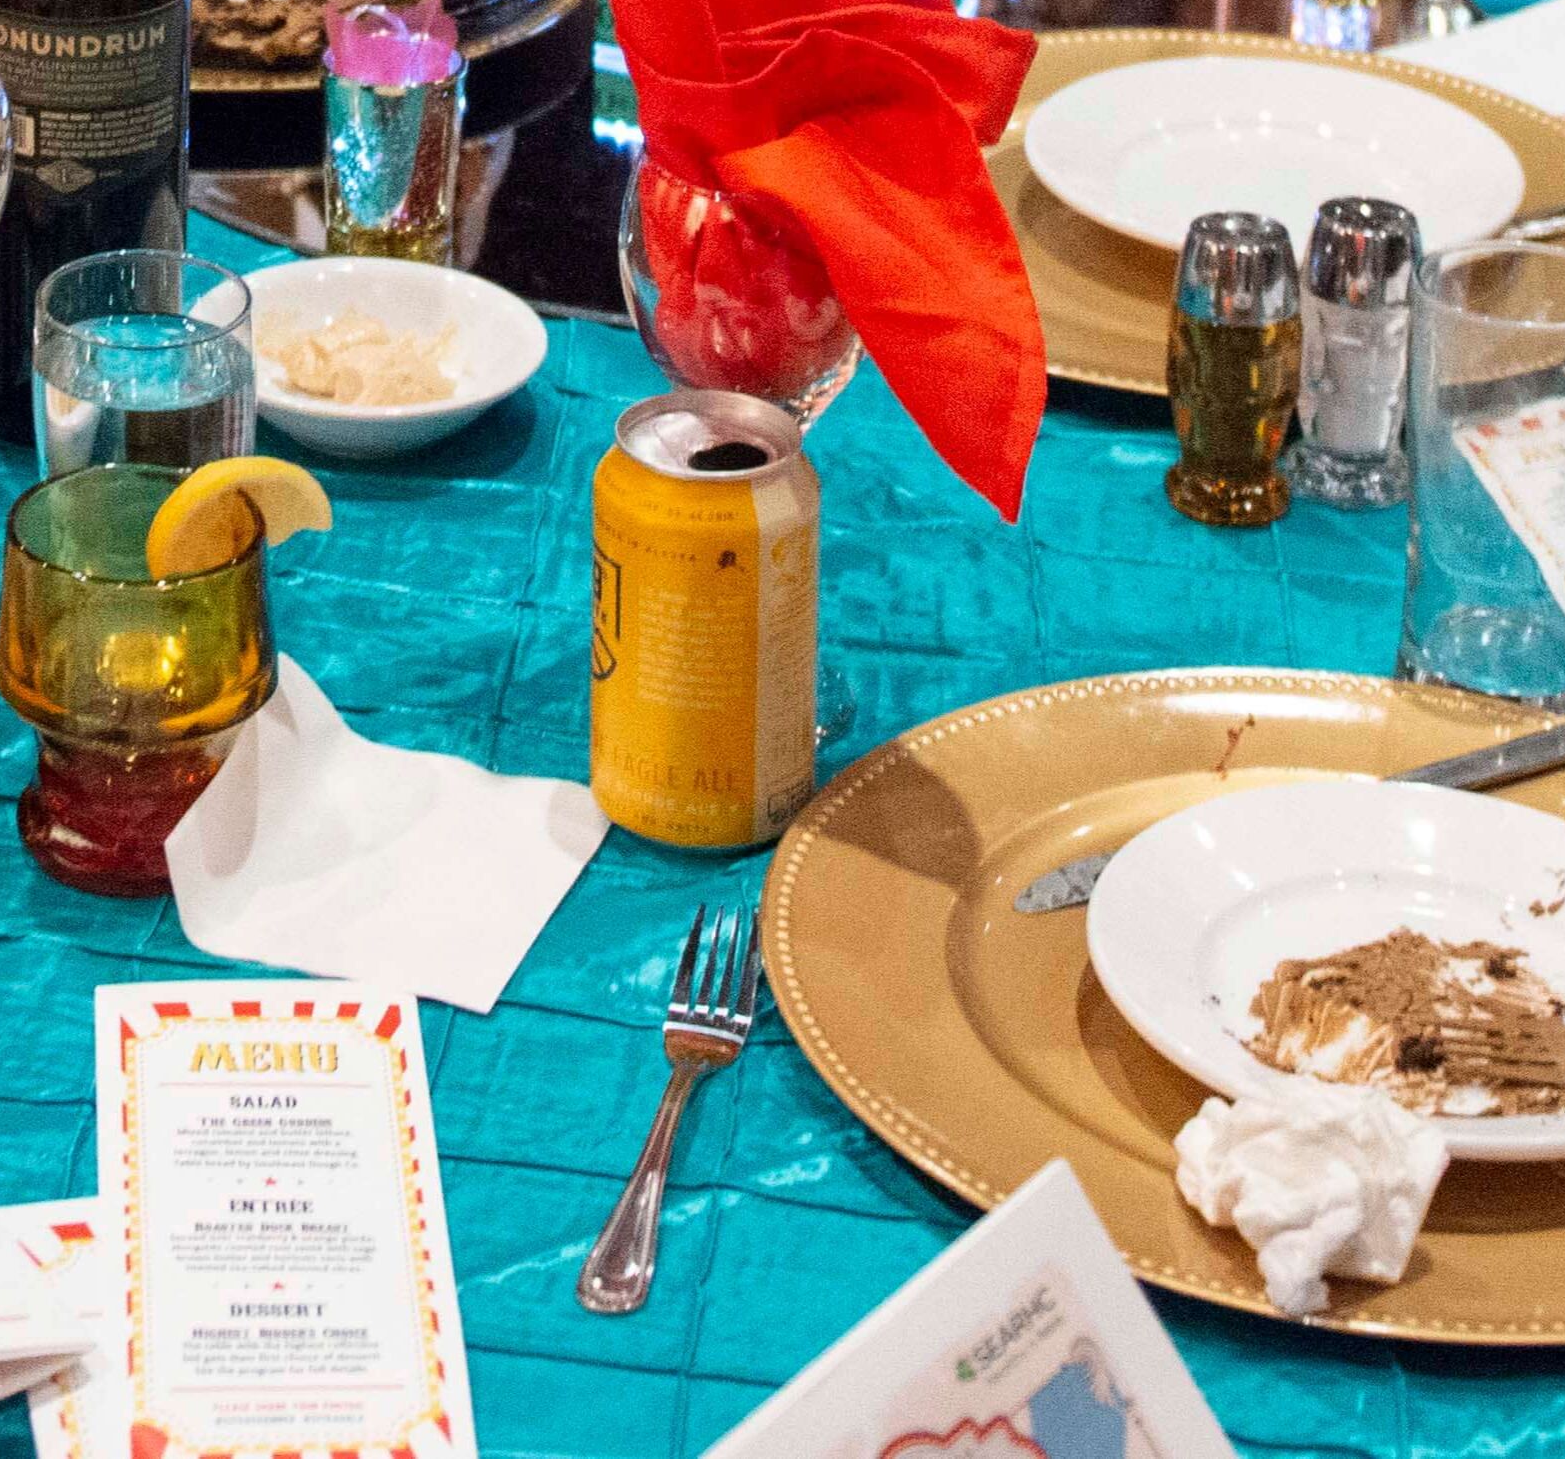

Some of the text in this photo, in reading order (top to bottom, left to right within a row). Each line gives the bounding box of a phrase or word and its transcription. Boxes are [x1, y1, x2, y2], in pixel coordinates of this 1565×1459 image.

[694, 768, 739, 793] ALE
[188, 1041, 339, 1073] MENU
[230, 1095, 298, 1109] SALAD
[230, 1303, 325, 1319] DESSERT
